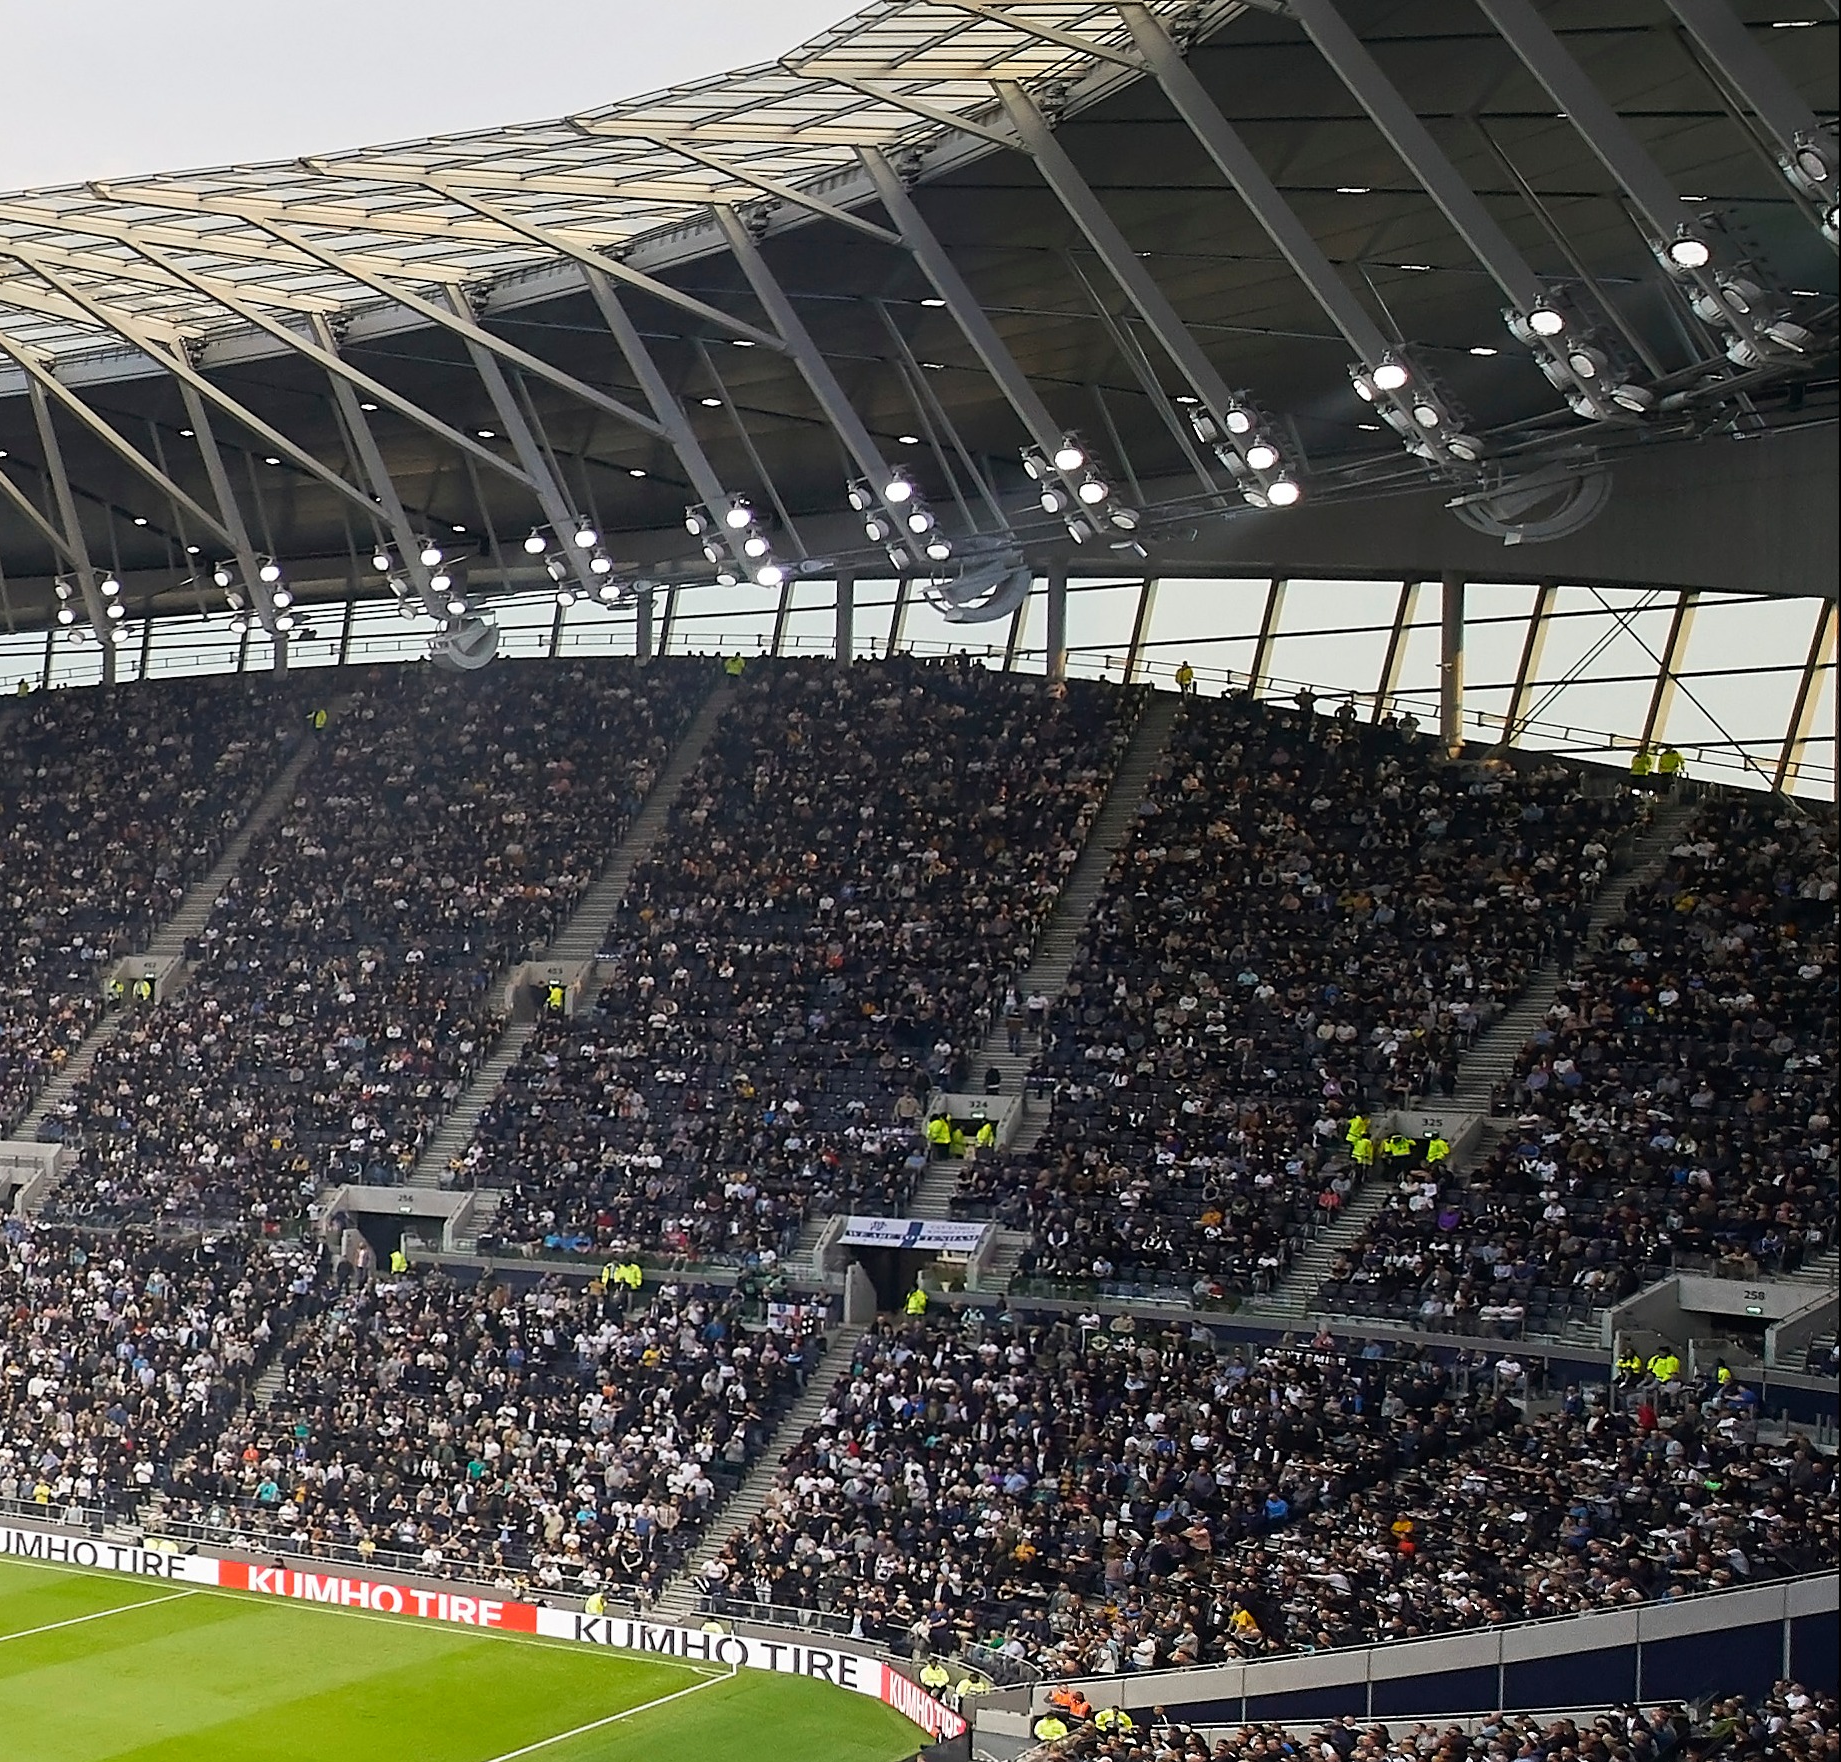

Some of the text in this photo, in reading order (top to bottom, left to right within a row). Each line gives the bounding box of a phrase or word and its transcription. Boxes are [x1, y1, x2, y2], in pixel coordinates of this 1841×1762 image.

[969, 1100, 987, 1109] 324
[1421, 1118, 1443, 1127] 325
[1744, 1290, 1766, 1300] 258
[247, 1564, 402, 1613] KUMHO
[577, 1616, 860, 1690] KUMHO TIRE
[890, 1671, 934, 1732] KUMHO
